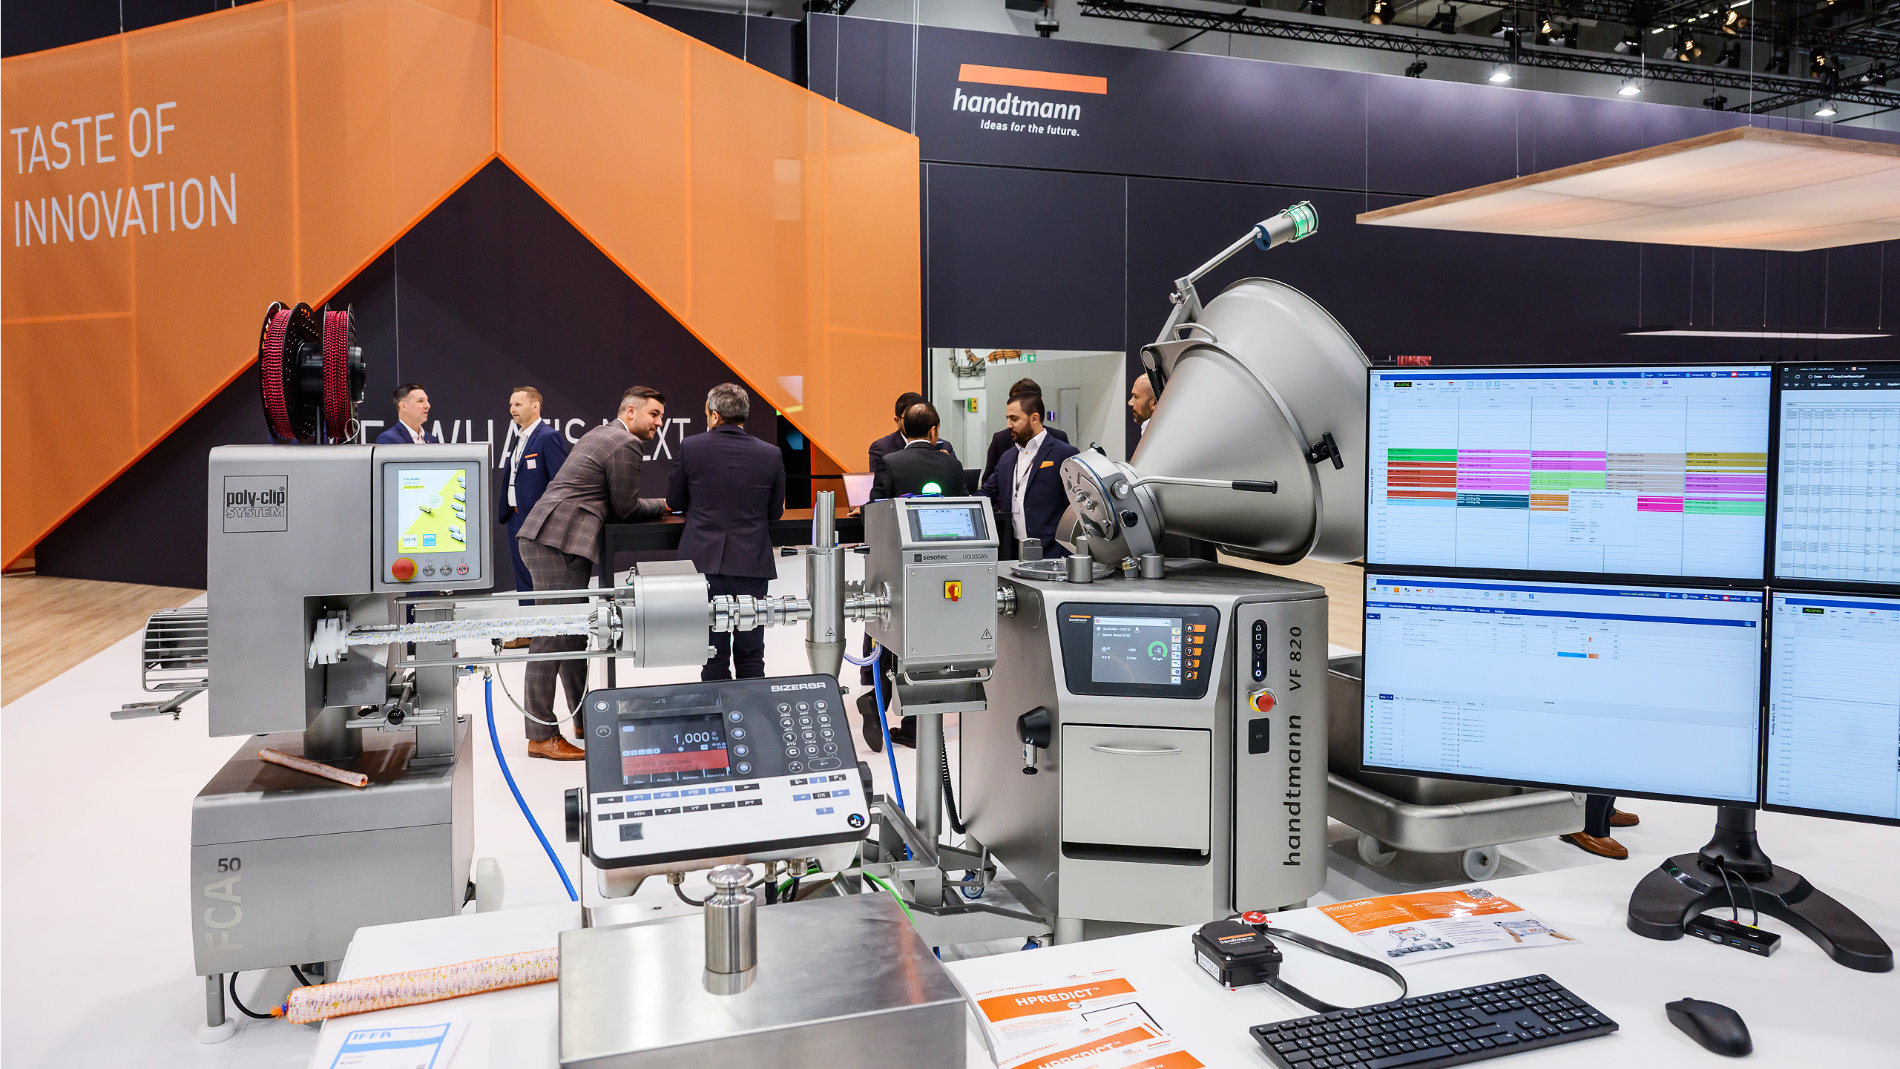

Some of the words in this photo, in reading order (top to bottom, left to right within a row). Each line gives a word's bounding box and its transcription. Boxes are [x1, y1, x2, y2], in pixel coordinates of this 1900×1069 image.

[953, 87, 1081, 121] handtmann
[10, 112, 116, 175] TASTE
[128, 101, 177, 158] OF
[980, 119, 1008, 131] Ideas
[1010, 122, 1026, 133] for
[1028, 123, 1045, 134] the
[1047, 125, 1080, 137] future.
[15, 172, 237, 248] INNOVATION
[226, 506, 285, 519] SYSTEM
[923, 553, 948, 561] sesotec
[1289, 626, 1302, 662] 820
[770, 682, 827, 693] BIZERBA
[1289, 668, 1302, 692] VF
[672, 731, 710, 746] 1,000
[1282, 714, 1301, 866] handtmann
[217, 857, 242, 874] 50
[203, 872, 243, 950] FCA
[352, 1031, 392, 1041] IFFA
